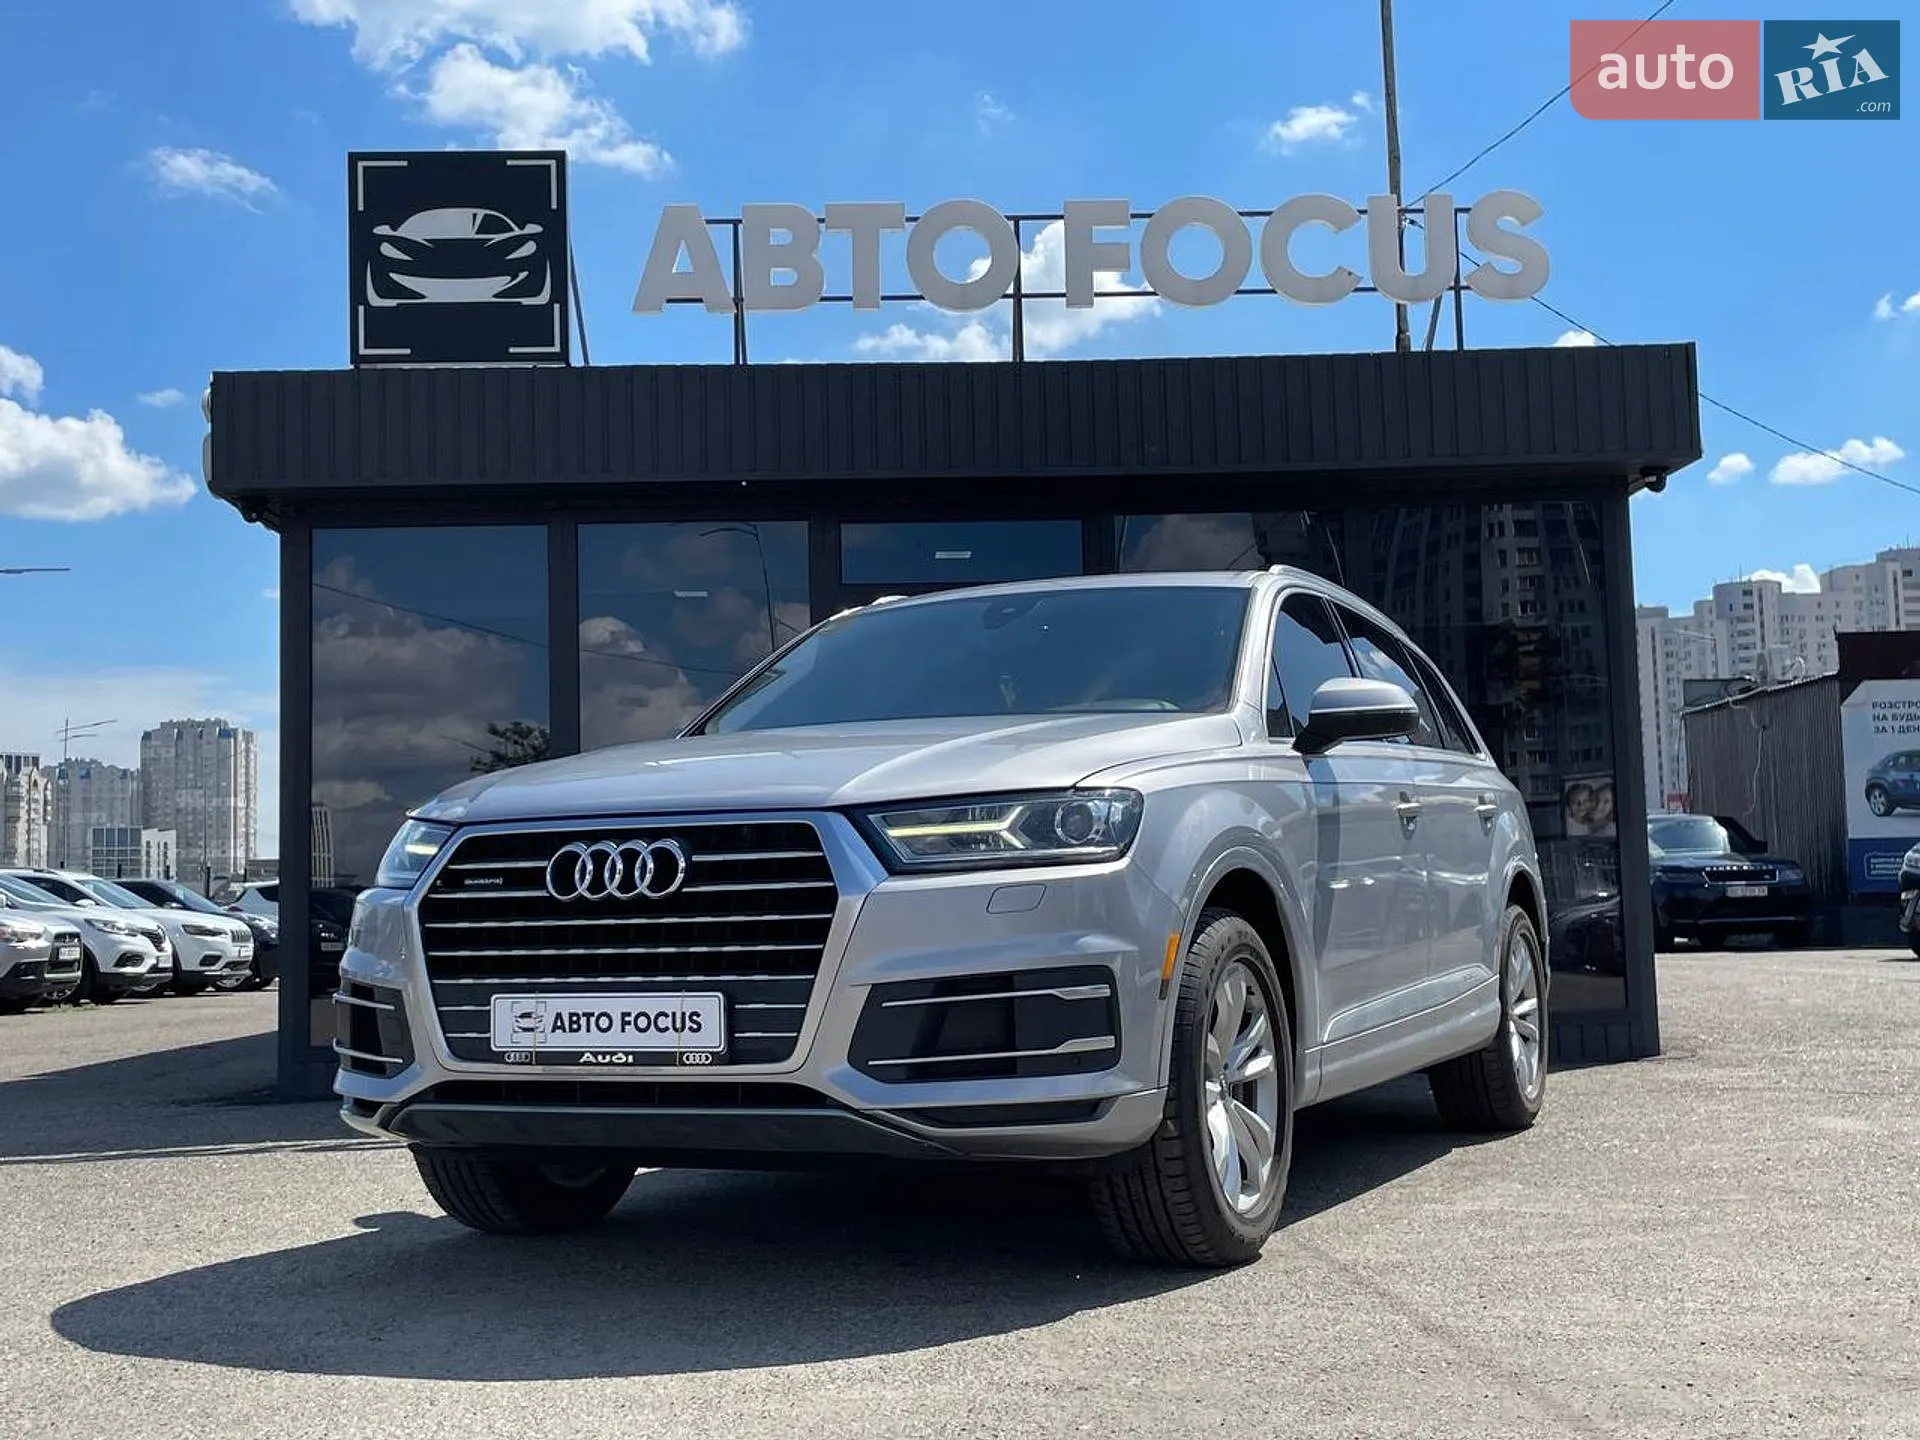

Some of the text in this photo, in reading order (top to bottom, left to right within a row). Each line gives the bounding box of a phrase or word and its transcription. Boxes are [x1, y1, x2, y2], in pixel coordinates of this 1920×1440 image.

[631, 189, 1552, 313] АВТО FOCUS
[550, 1010, 702, 1034] АВТО FOCUS
[578, 1052, 634, 1064] Audi
